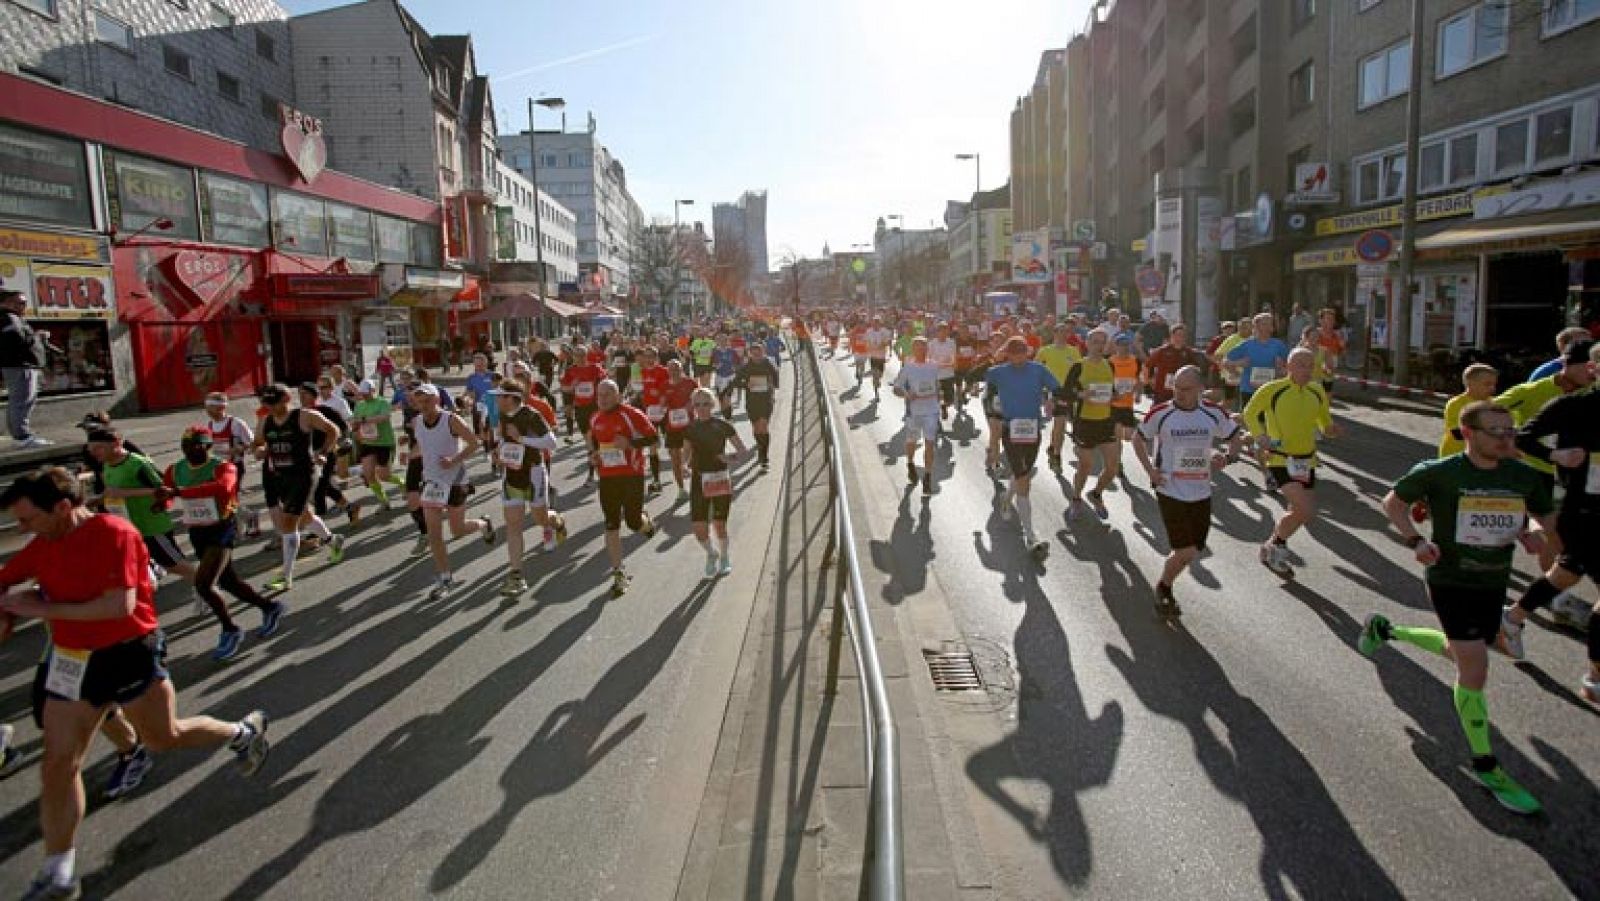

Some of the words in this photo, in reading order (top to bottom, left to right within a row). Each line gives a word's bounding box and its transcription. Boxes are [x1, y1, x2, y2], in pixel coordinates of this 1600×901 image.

[282, 104, 322, 134] EROS
[184, 260, 222, 274] EROS
[1470, 514, 1514, 529] 20303
